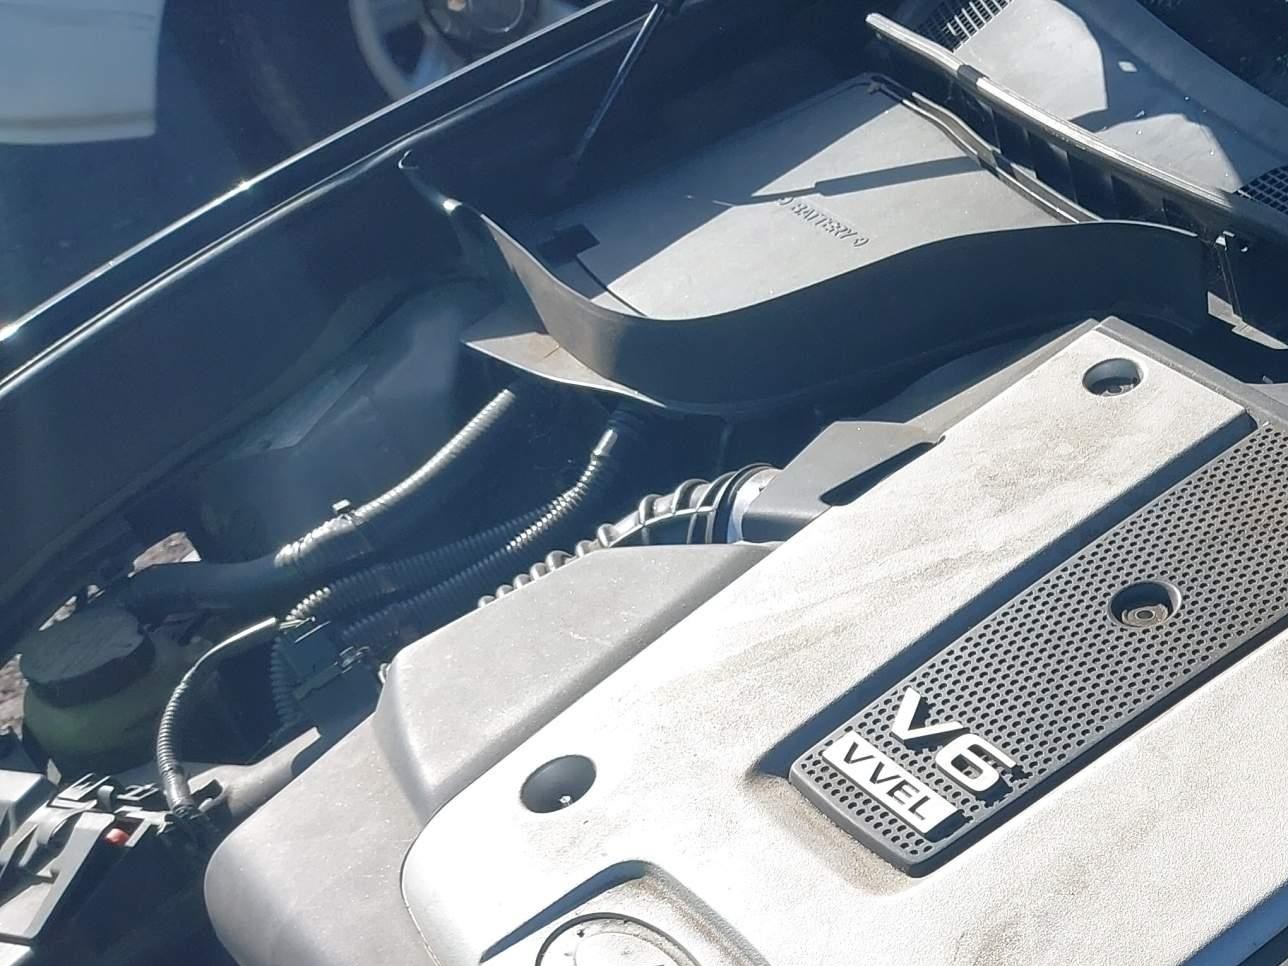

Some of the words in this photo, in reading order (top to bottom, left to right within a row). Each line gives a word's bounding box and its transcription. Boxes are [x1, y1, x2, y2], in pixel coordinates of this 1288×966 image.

[790, 203, 858, 240] BATTERY
[891, 686, 1017, 792] V6
[843, 741, 931, 821] VVEL
